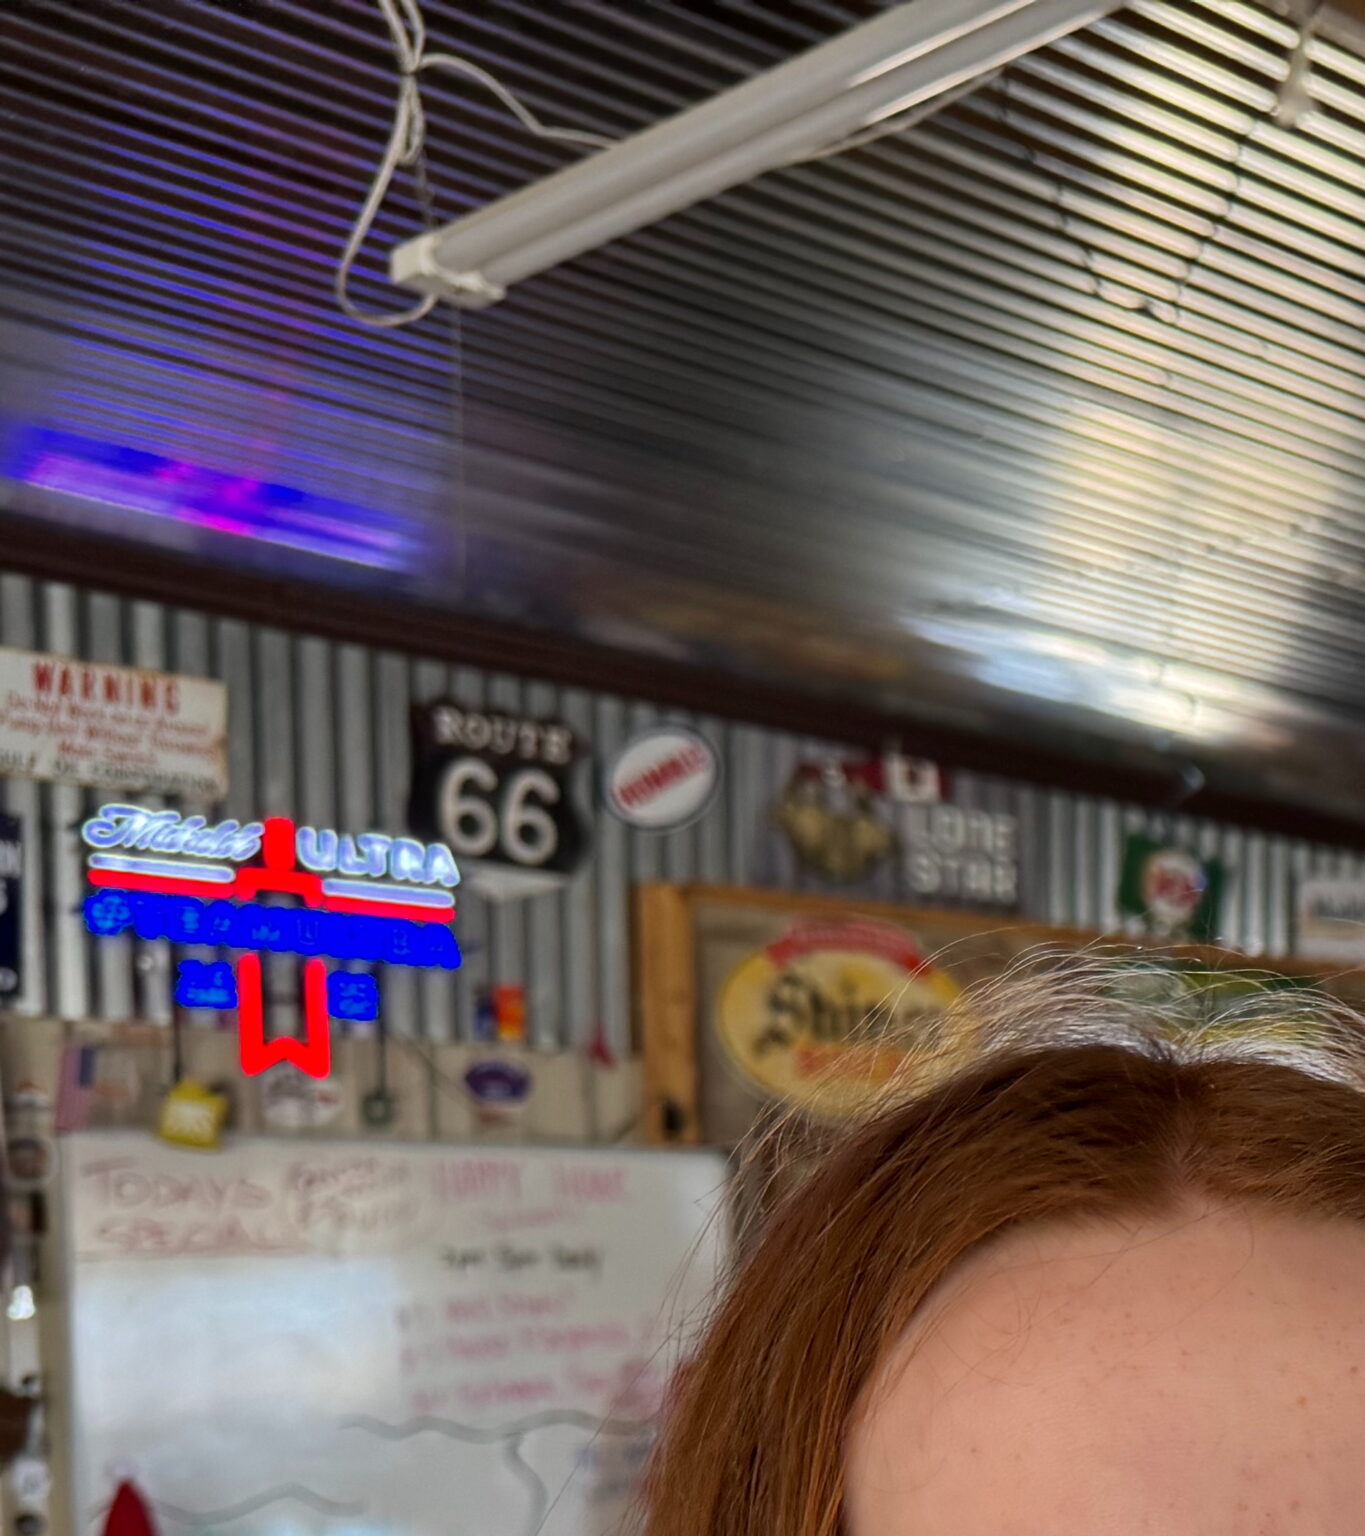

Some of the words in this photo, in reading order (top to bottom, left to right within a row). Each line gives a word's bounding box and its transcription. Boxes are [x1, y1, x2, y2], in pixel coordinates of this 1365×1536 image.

[33, 663, 180, 717] WARNING
[433, 704, 573, 765] ROUTE
[440, 757, 560, 866] 66
[296, 826, 461, 888] ULTRA
